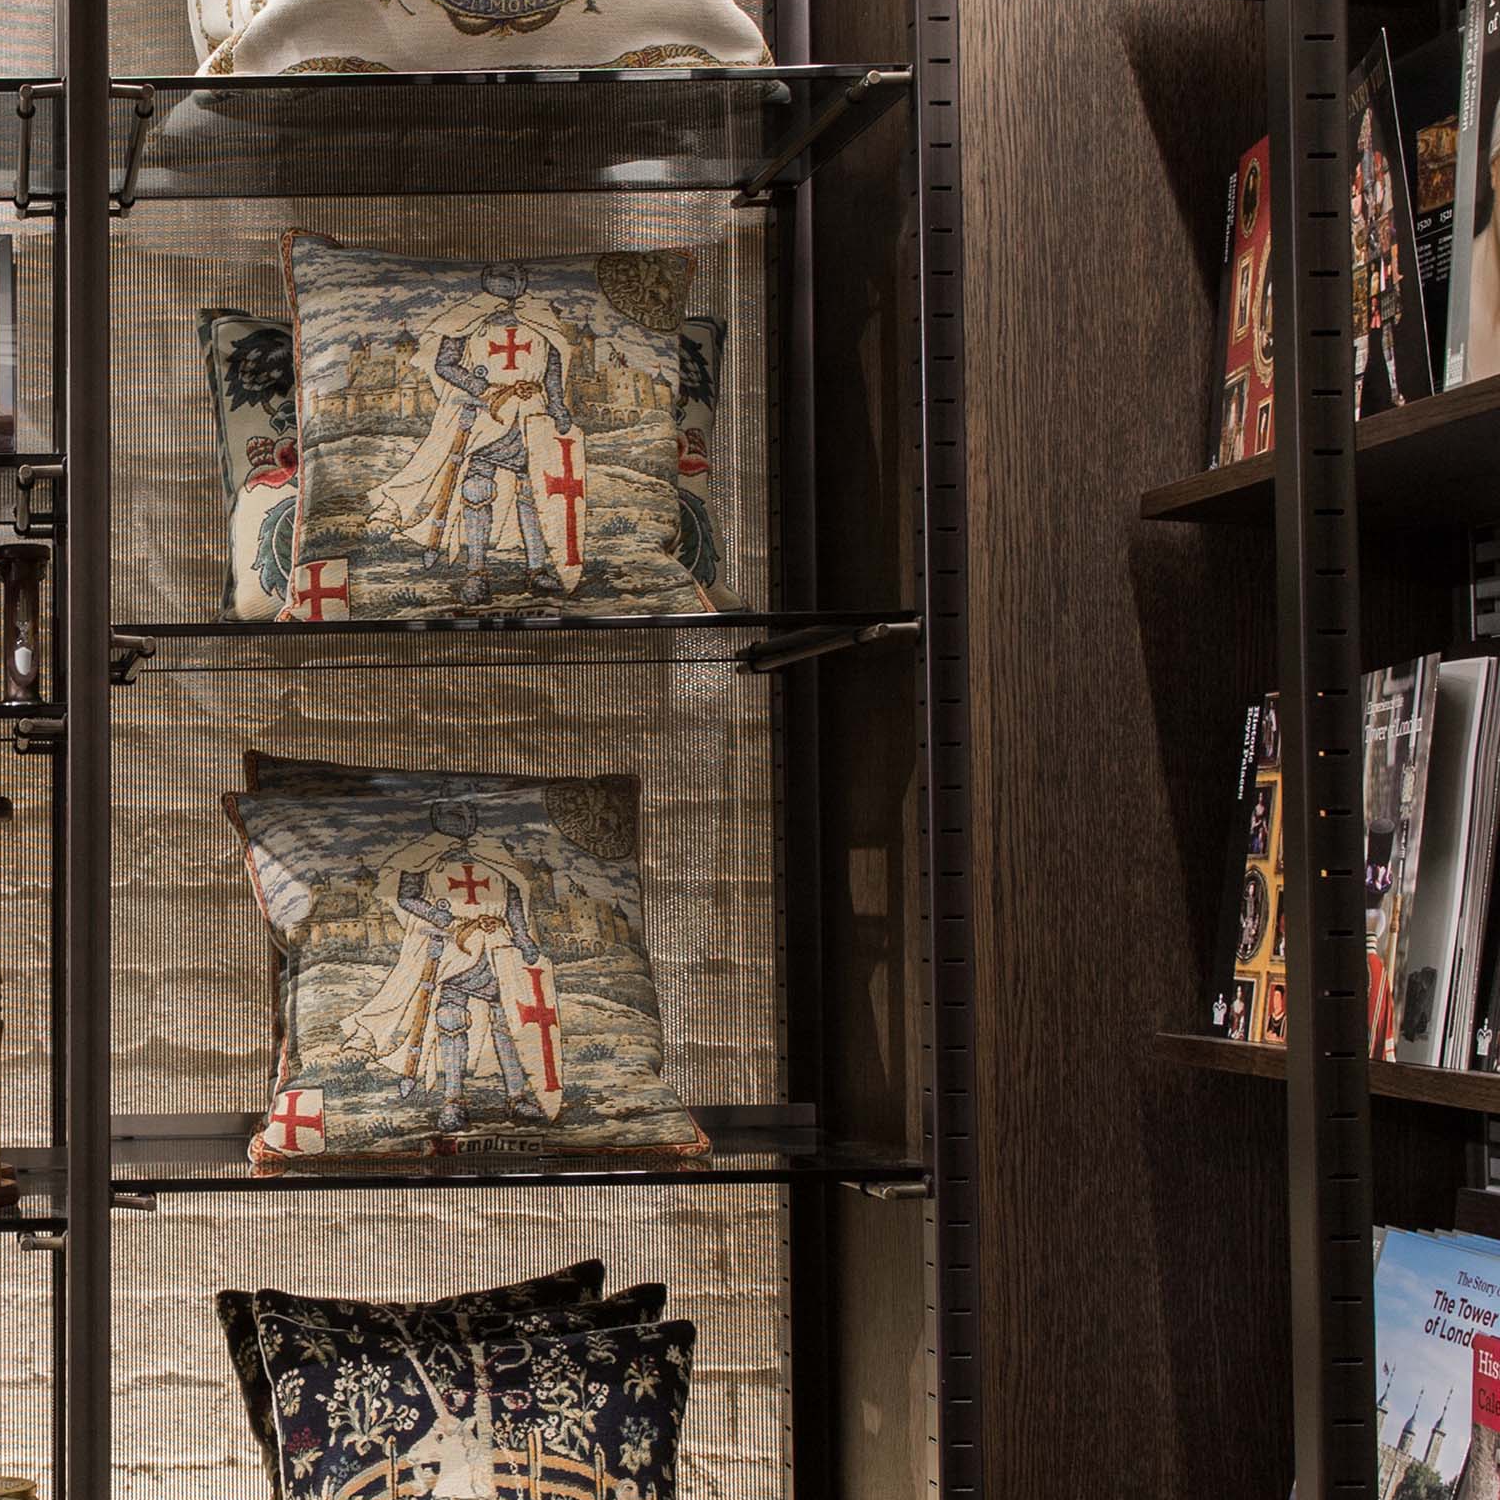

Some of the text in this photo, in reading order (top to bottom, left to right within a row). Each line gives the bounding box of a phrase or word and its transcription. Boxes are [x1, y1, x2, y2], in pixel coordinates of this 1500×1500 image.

[1461, 68, 1472, 132] London
[1237, 706, 1254, 801] Royal Palaces
[1248, 705, 1261, 764] Historic
[1457, 1270, 1497, 1298] The Story
[1432, 1289, 1499, 1329] The Tower
[1424, 1316, 1476, 1349] of Lond
[1478, 1349, 1500, 1380] His
